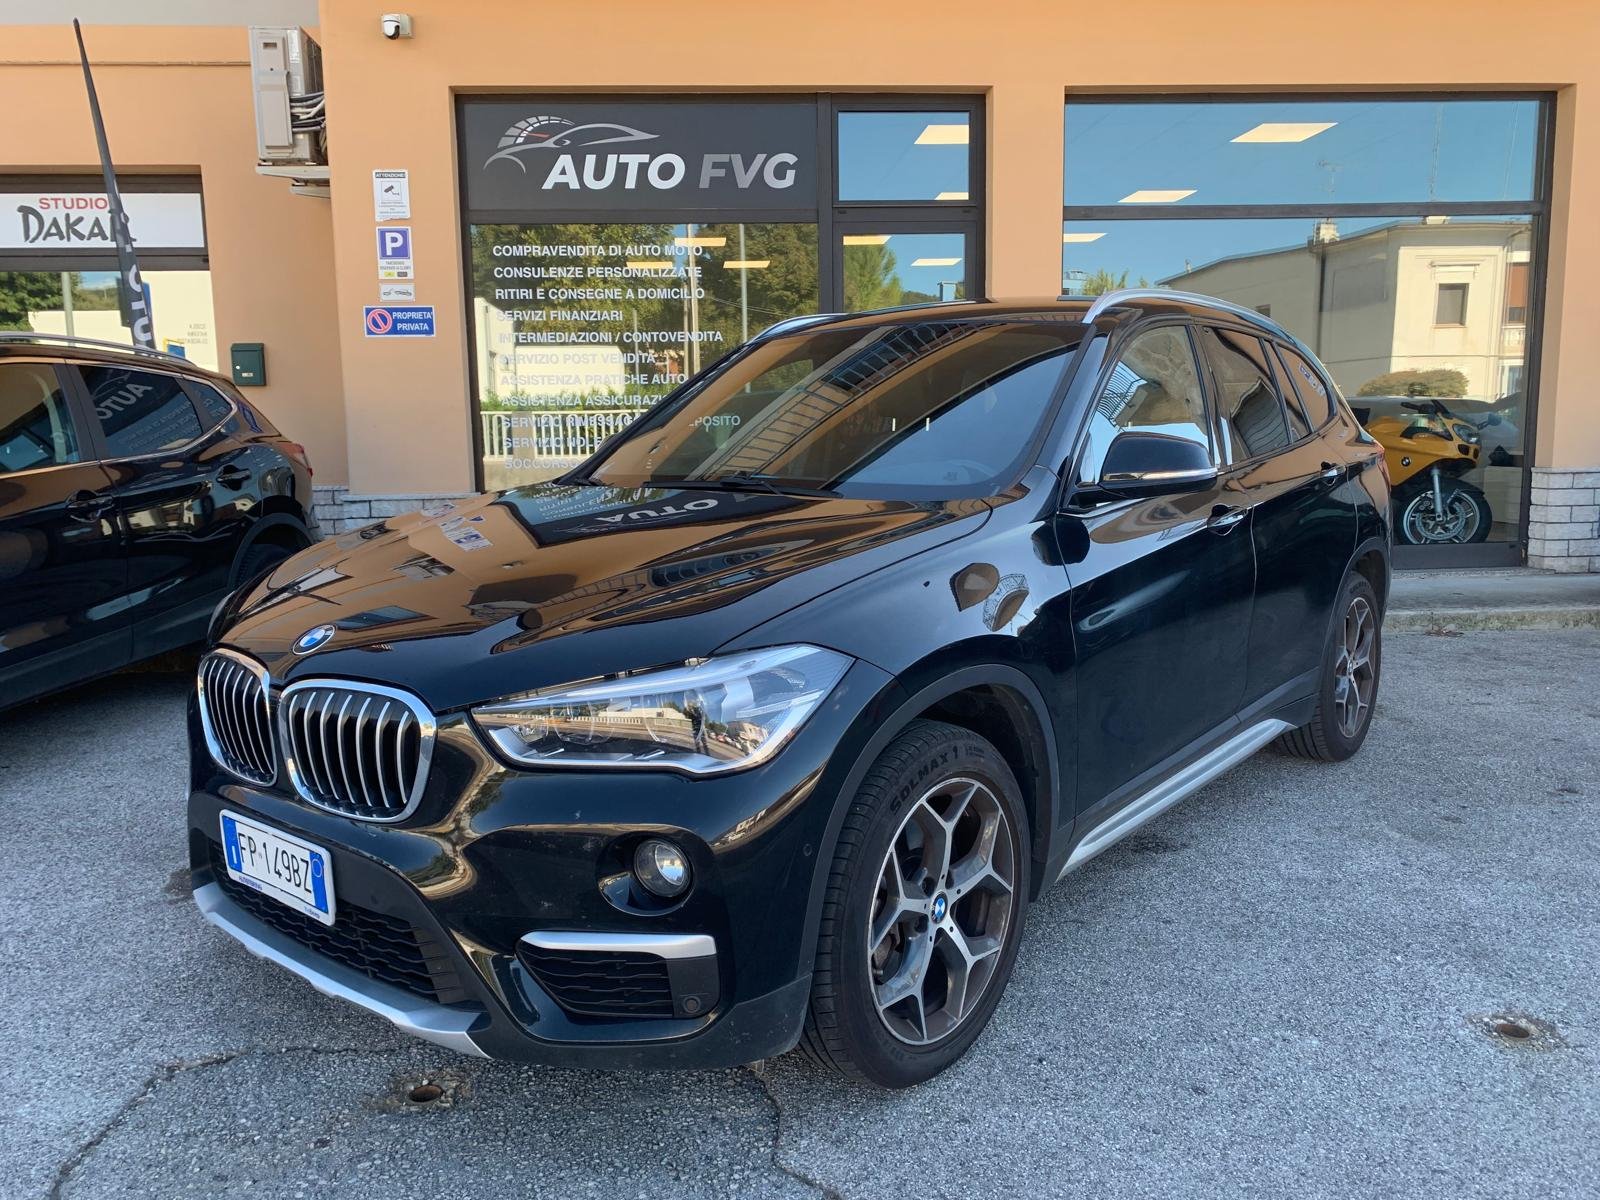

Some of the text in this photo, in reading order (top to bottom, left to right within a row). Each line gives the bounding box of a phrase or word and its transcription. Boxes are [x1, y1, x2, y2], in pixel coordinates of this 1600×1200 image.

[541, 152, 799, 190] AUTO FVG
[39, 198, 108, 210] STUDIO
[385, 232, 404, 256] P
[492, 245, 703, 257] COMPRAVENDITA DI AUTO MOTO
[494, 267, 702, 278] CONSULENZE PERSONALIZZATE
[496, 288, 705, 300] RITIRI E CONSEGNE A DOMICILIO
[496, 310, 623, 321] SERVIZI FINANZIARI
[397, 322, 429, 331] PRIVATA
[499, 332, 613, 343] INTERMEDIAZIONI
[622, 331, 724, 343] CONTOVENDITA
[499, 353, 656, 365] SERVIZIO POST VENDITA
[500, 373, 688, 385] ASSISTENZA PRATICHE AUTO
[501, 395, 582, 406] ASSISTENZA
[501, 417, 561, 428] SERVIZIO
[502, 437, 563, 448] SERVIZIO
